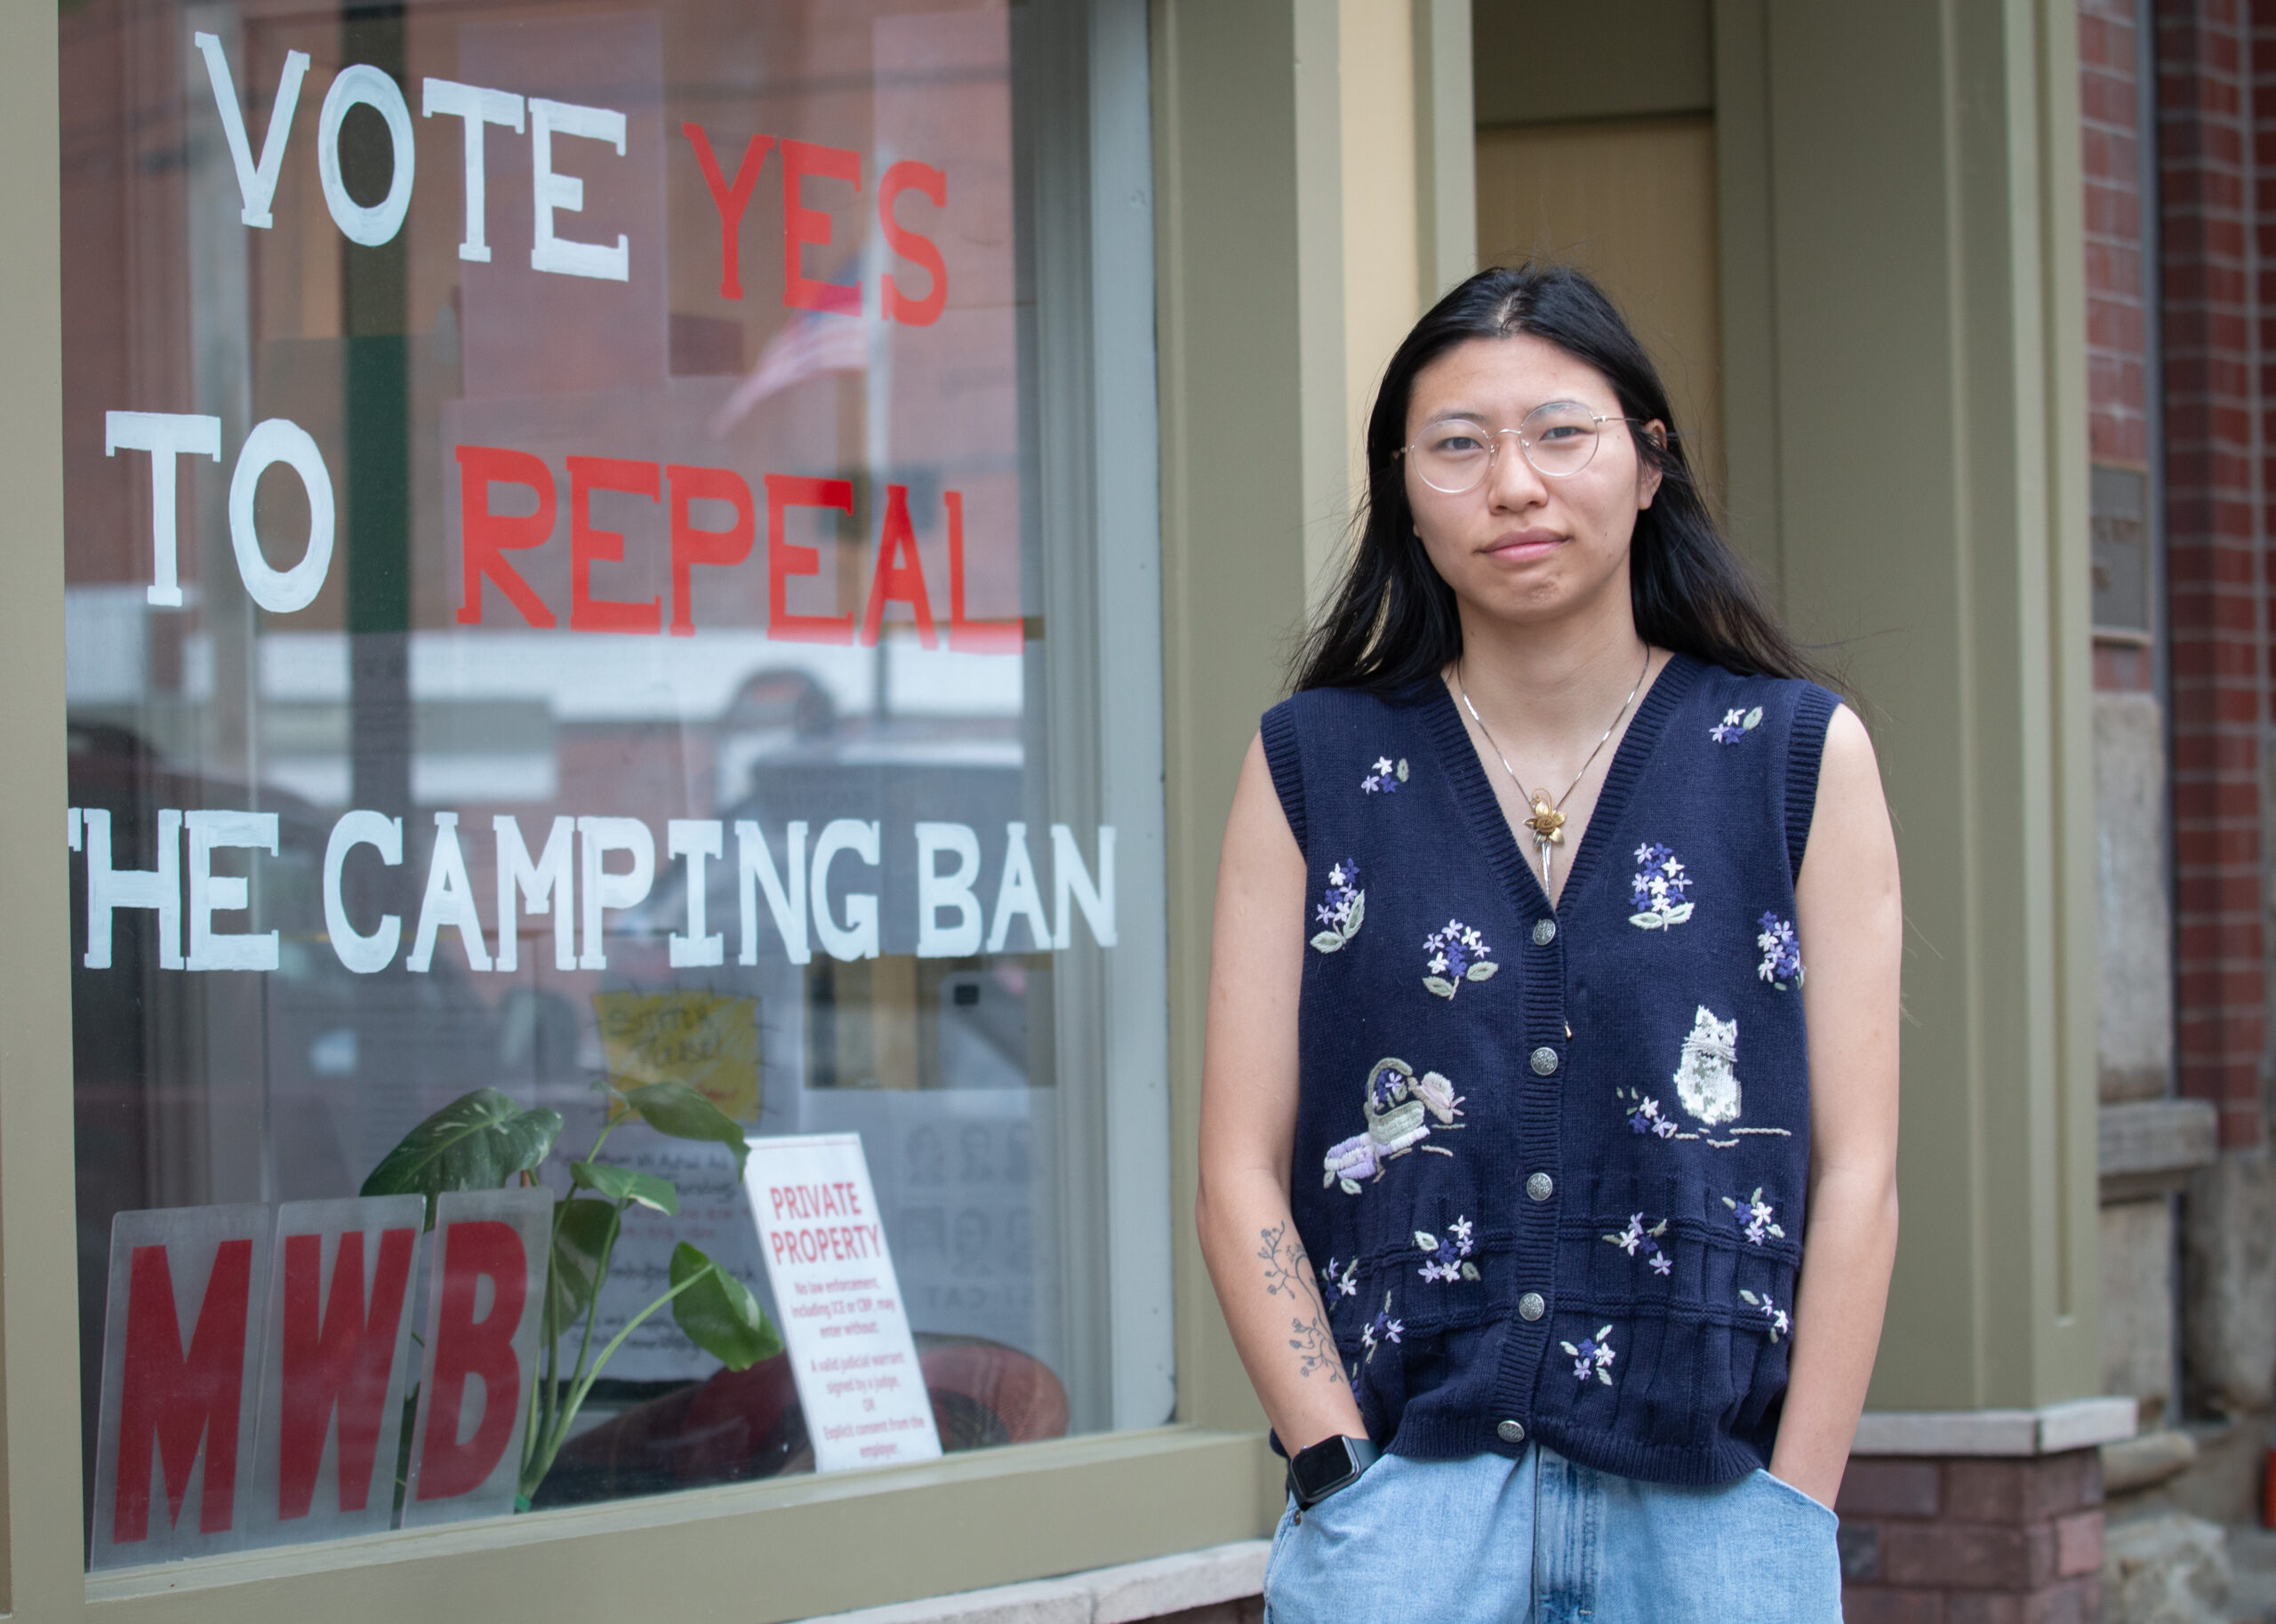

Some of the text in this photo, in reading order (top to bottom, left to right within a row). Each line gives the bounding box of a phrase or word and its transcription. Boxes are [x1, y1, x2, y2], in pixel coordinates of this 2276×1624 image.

[195, 31, 949, 326] VOTE YES
[105, 410, 1024, 655] TO REPEAL
[68, 807, 1118, 973] HE CAMPING BAN
[770, 1182, 862, 1220] PRIVATE
[770, 1224, 881, 1265] PROPERTY
[794, 1283, 808, 1295] No
[809, 1280, 823, 1293] law
[791, 1300, 831, 1319] including
[831, 1300, 845, 1315] ICE
[847, 1300, 856, 1312] or
[877, 1298, 895, 1313] may
[820, 1324, 842, 1339] enter
[819, 1357, 839, 1372] valid
[841, 1354, 870, 1372] judicial
[113, 1220, 529, 1545] MWB
[827, 1380, 854, 1396] signed
[854, 1379, 867, 1393] by
[823, 1415, 926, 1441] Explicit consent from the
